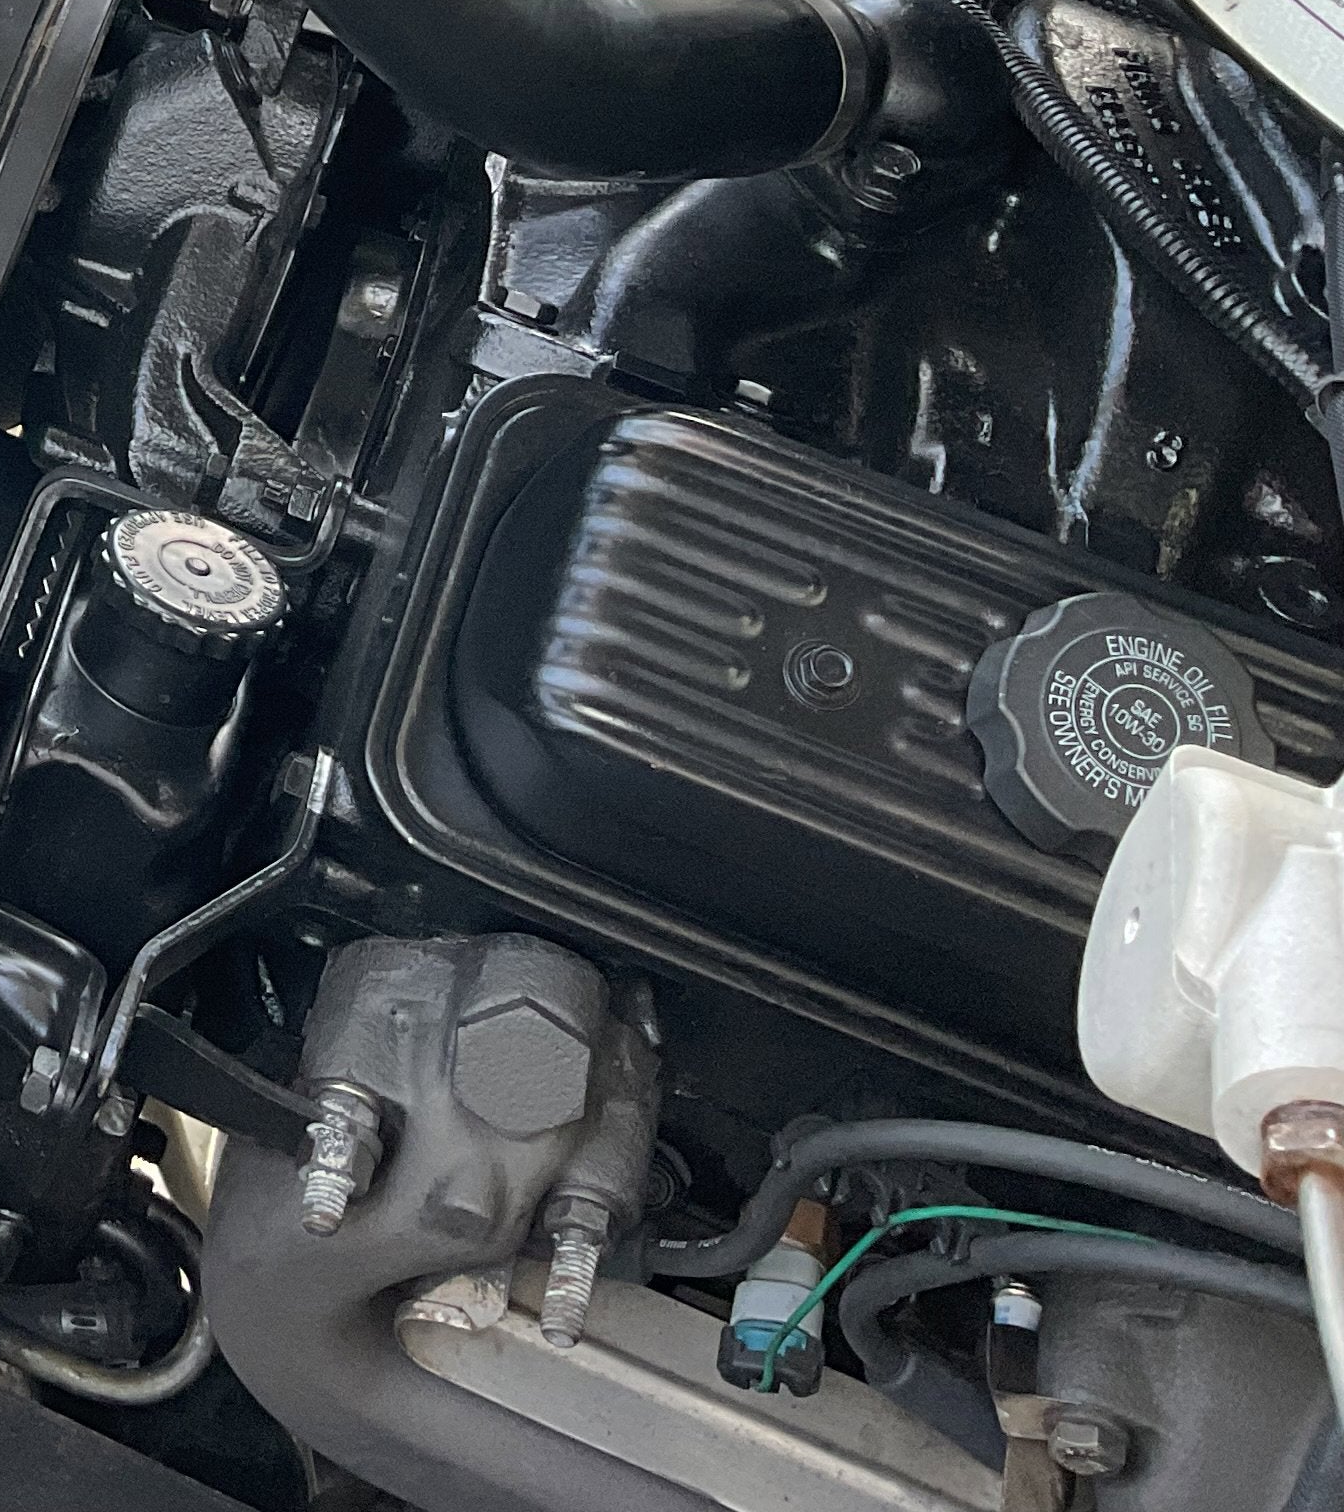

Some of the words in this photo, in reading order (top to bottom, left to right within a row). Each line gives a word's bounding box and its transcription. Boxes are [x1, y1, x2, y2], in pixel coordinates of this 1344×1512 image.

[1048, 670, 1076, 708] SEE
[1106, 635, 1184, 672] ENGINE
[1183, 666, 1214, 700] OIL
[1205, 704, 1233, 743] FILL
[1115, 661, 1138, 678] API
[1143, 665, 1195, 708] SERVICE
[1079, 682, 1100, 736] ENERGY
[1090, 739, 1161, 782] CONSERV
[1109, 702, 1166, 754] 10W-30
[1130, 699, 1162, 729] SAE
[1049, 710, 1121, 799] OWNER'S
